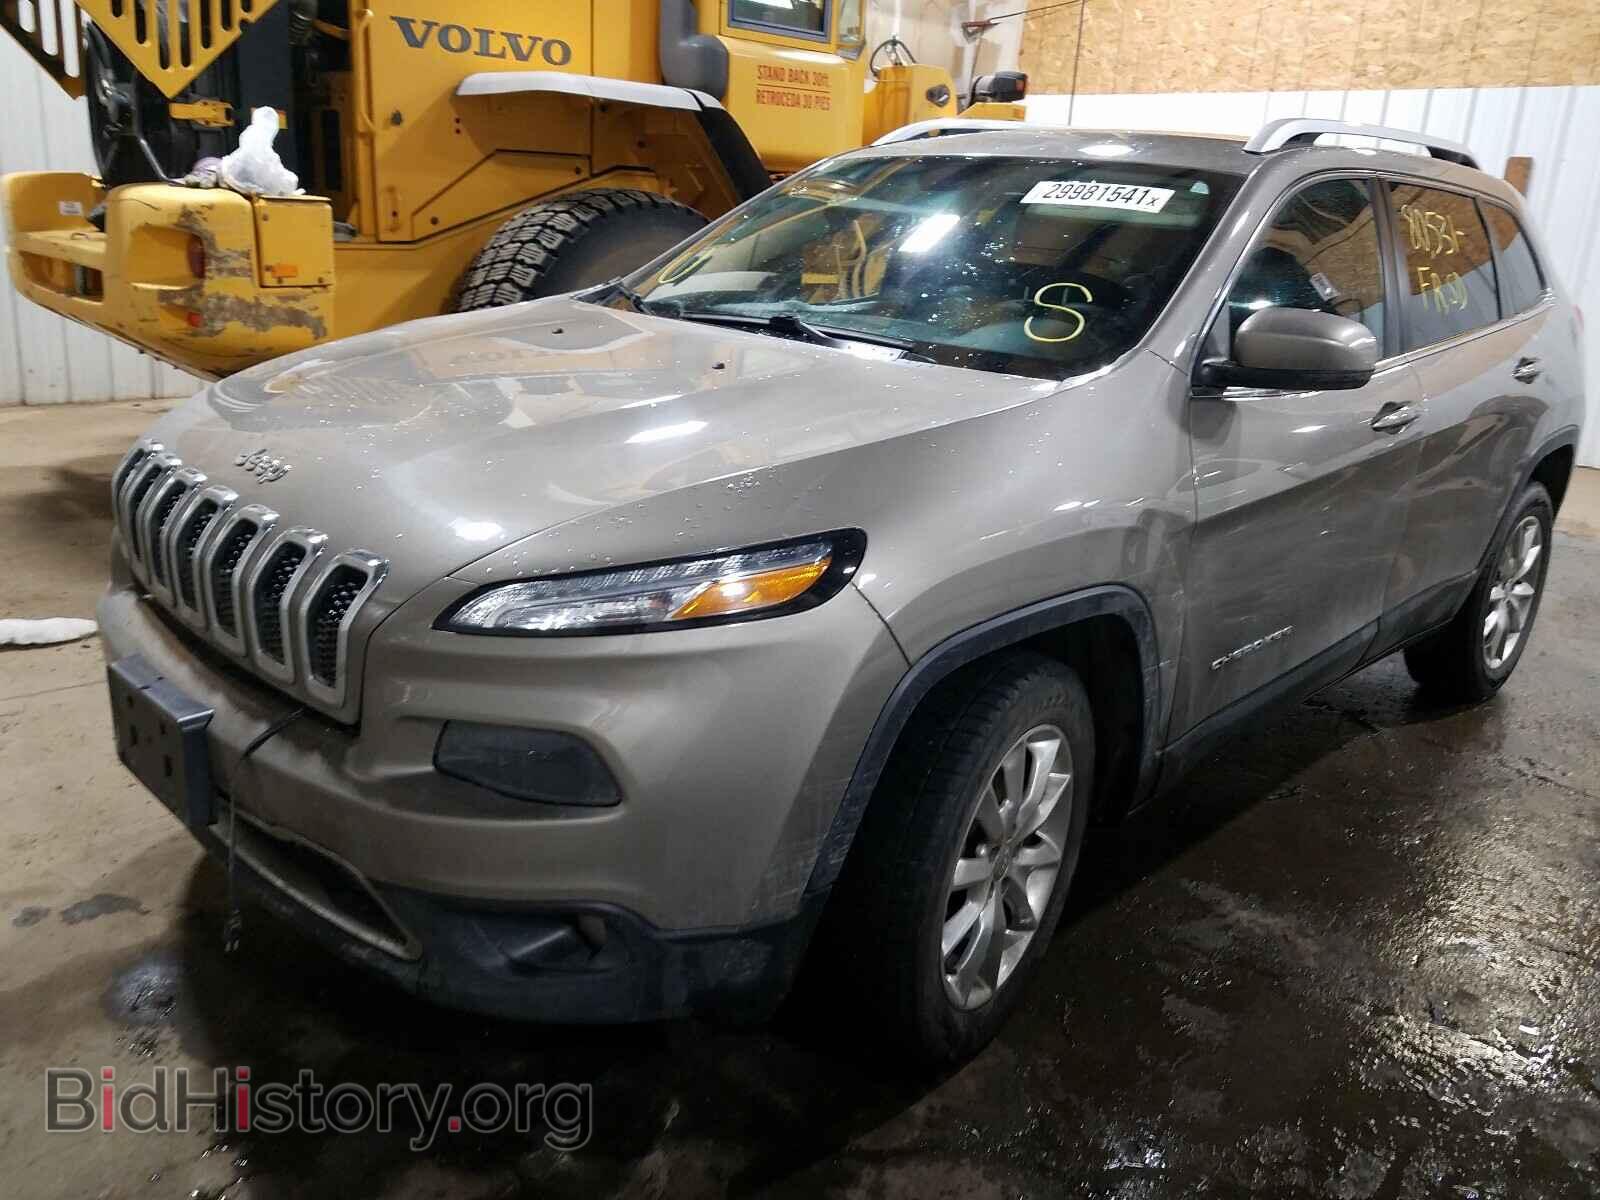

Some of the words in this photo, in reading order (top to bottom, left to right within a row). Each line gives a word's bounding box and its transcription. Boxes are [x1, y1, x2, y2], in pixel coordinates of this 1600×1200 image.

[389, 15, 572, 66] VOLVO
[757, 64, 785, 82] STAND
[1023, 282, 1093, 342] S
[234, 448, 290, 485] Jeep
